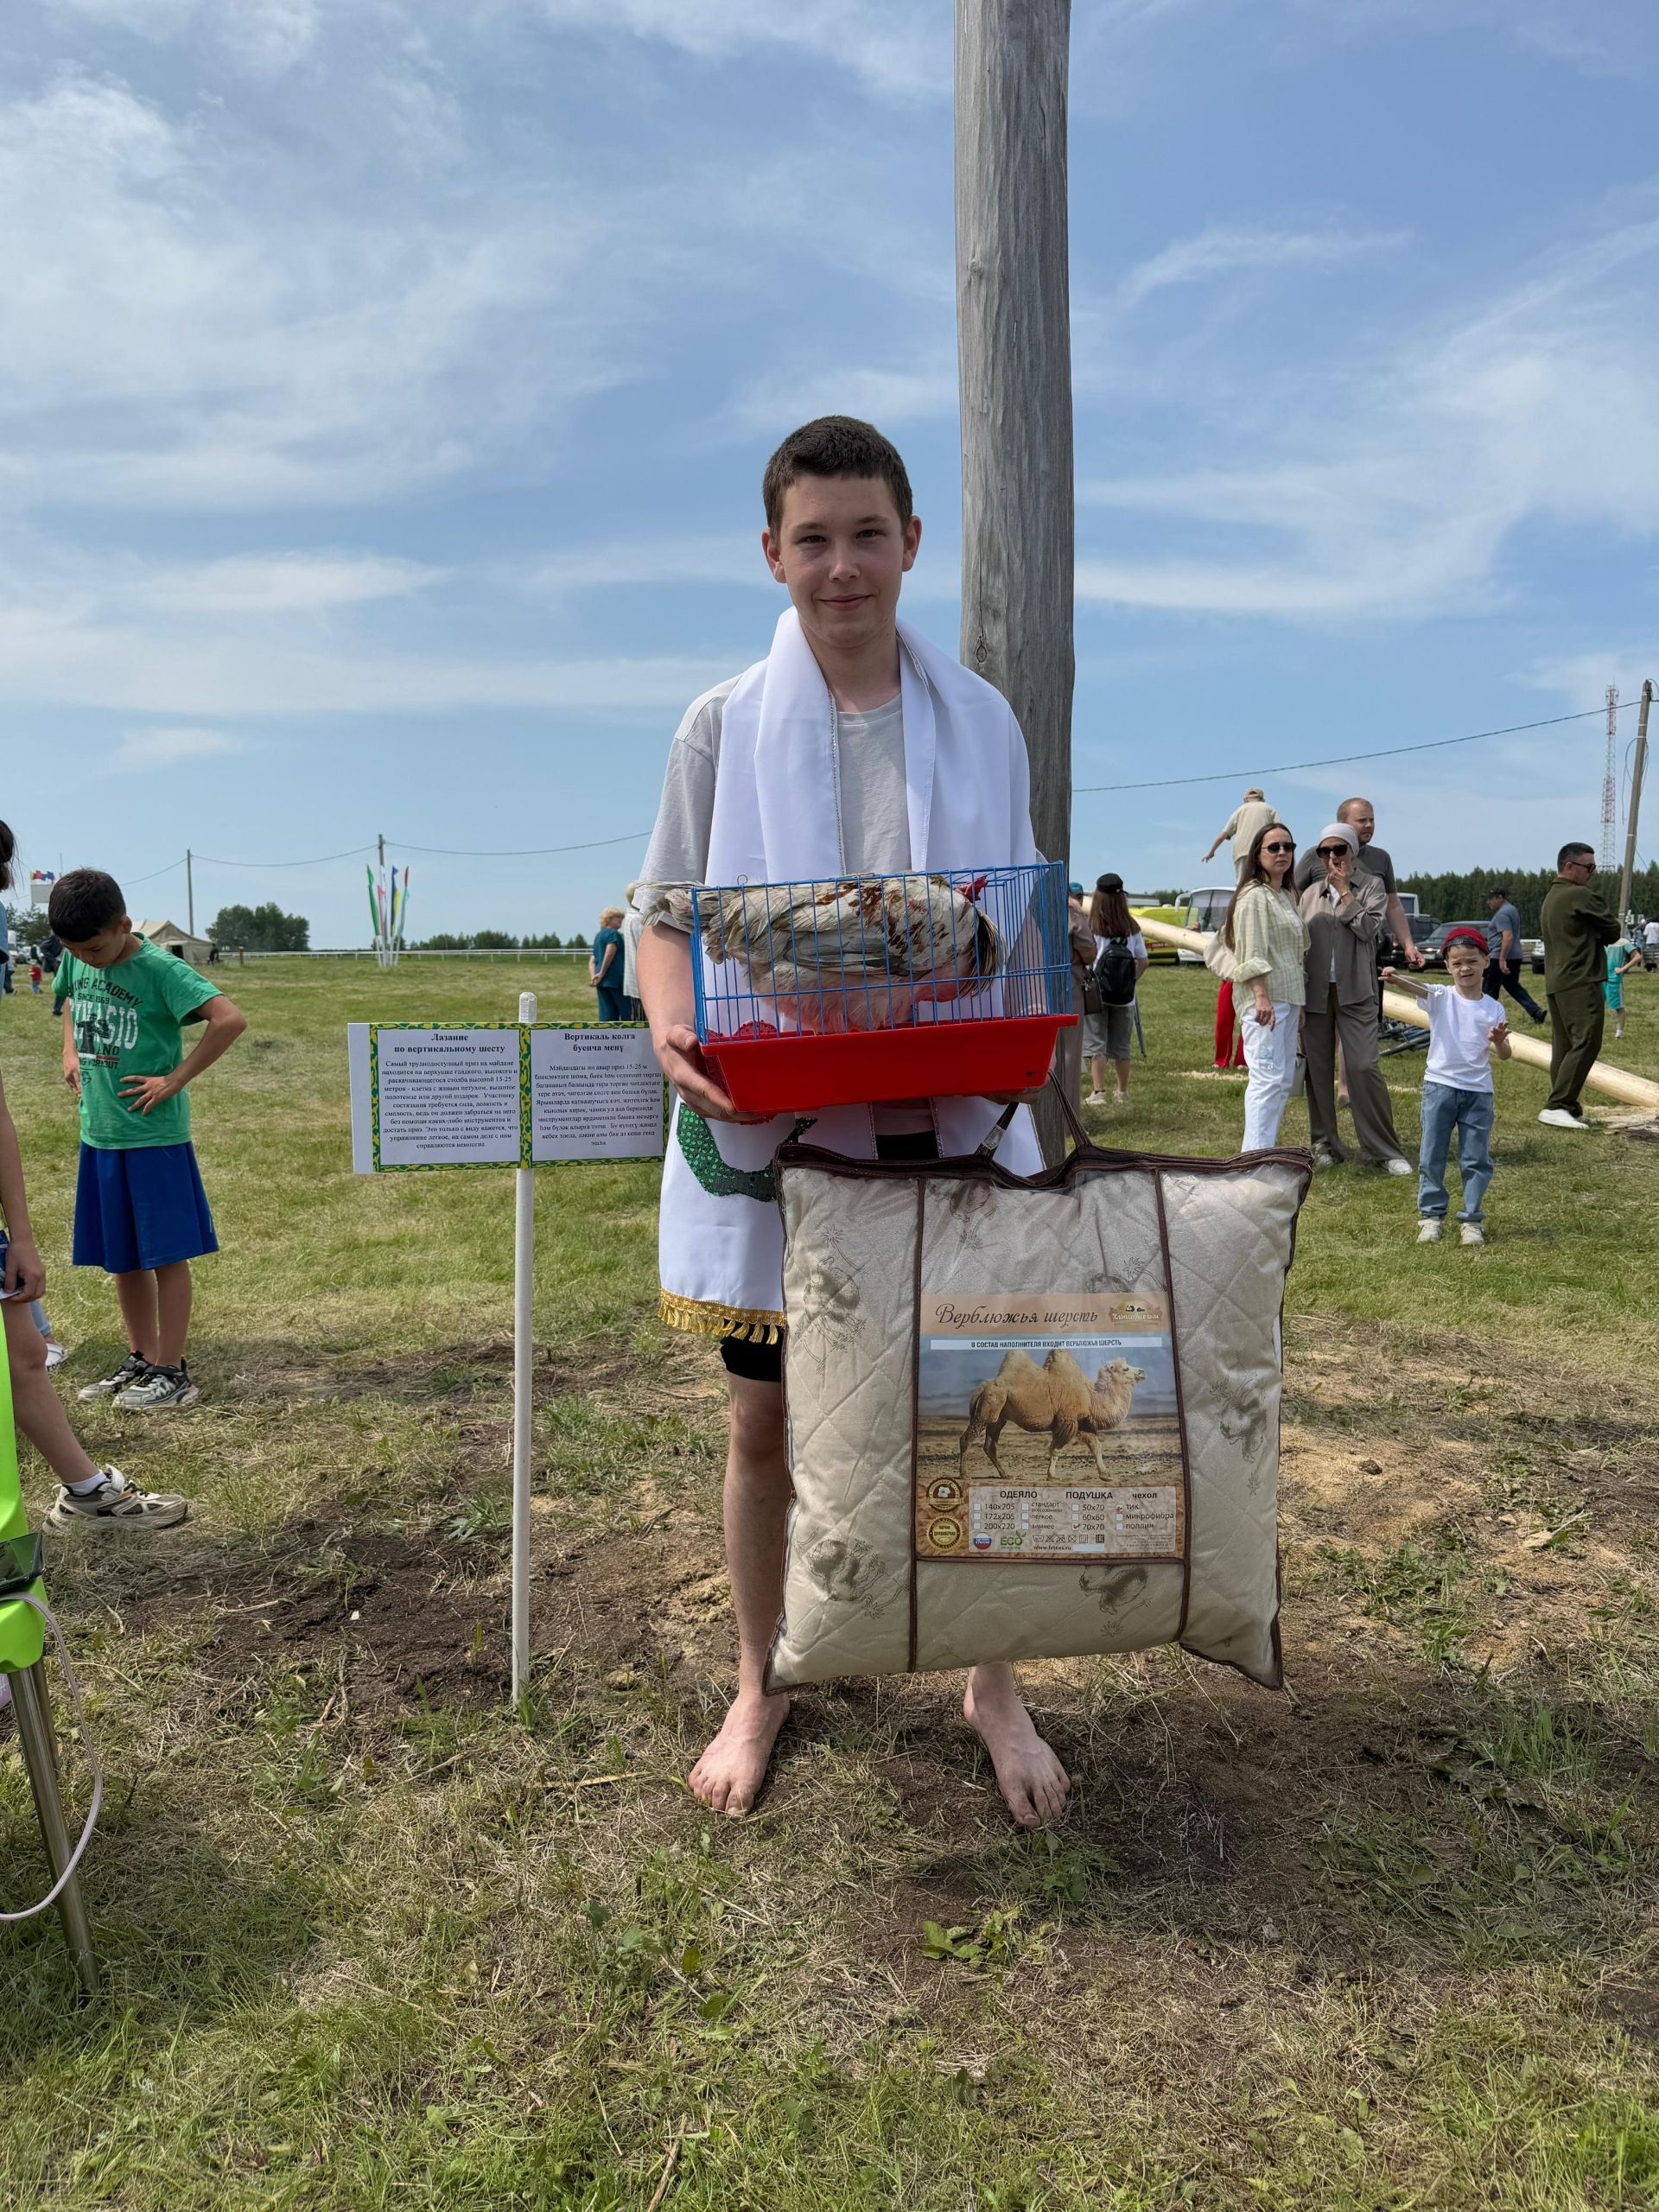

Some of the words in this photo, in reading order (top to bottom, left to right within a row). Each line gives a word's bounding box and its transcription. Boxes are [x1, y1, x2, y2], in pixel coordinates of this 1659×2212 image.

[92, 978, 143, 1007] ACADEMY
[564, 1033, 610, 1041] Вертикаль
[479, 1045, 505, 1053] шесту
[573, 1044, 601, 1052] буенча
[431, 1092, 452, 1101] другой
[935, 1303, 1039, 1329] Верблюжья
[1044, 1309, 1097, 1328] шерсть
[1066, 1491, 1113, 1500] ПОДУШКА
